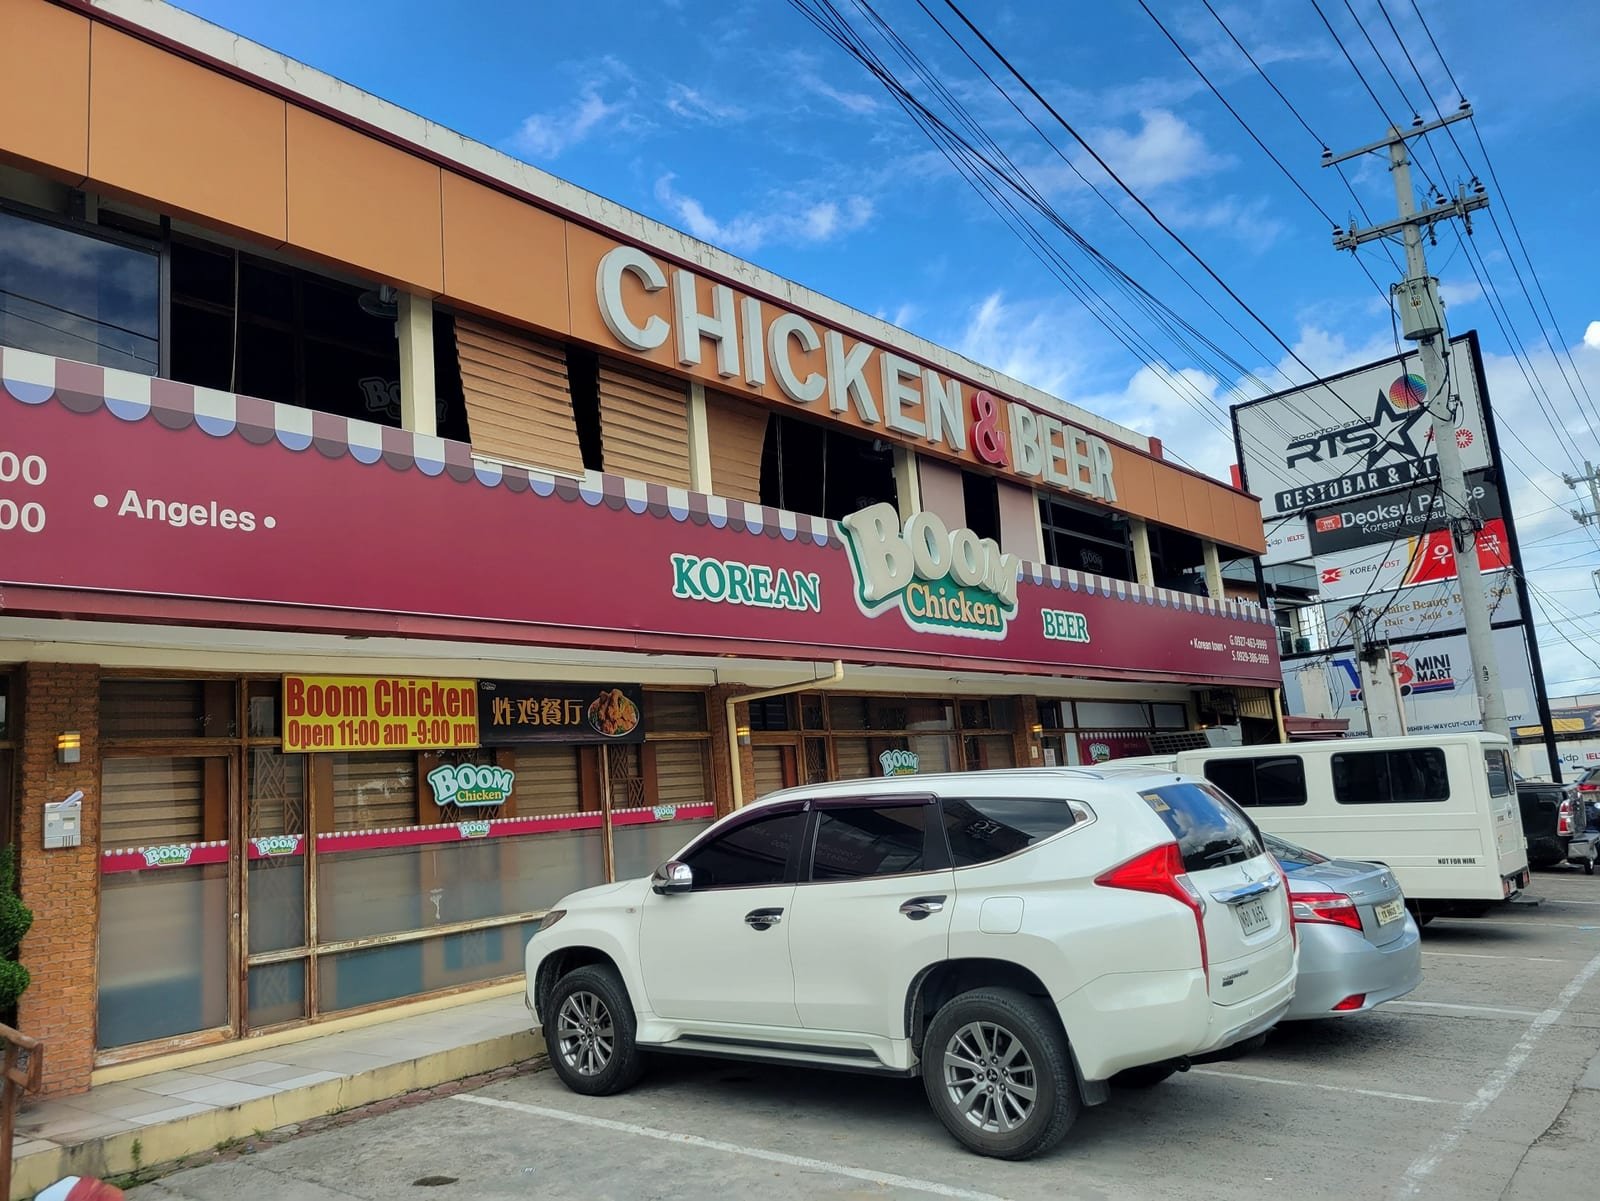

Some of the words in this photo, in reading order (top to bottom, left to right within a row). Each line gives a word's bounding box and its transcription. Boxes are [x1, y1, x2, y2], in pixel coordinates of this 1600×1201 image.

[597, 246, 966, 452] CHICKEN
[970, 389, 1008, 468] &
[1007, 402, 1117, 503] BEER
[1409, 457, 1436, 480] KT
[118, 489, 256, 532] Angeles
[1341, 502, 1412, 528] Deoksu
[1362, 519, 1401, 534] Korean
[842, 501, 1019, 608] BOOM
[1349, 563, 1378, 575] KOREA
[672, 554, 820, 612] KOREAN
[905, 583, 1001, 626] Chicken
[1042, 609, 1089, 642] BEER
[1415, 653, 1450, 672] MINI
[1417, 667, 1452, 683] MART
[287, 677, 368, 718] Boom
[374, 679, 476, 718] Chicken
[492, 696, 584, 726] 炸鸡餐厅
[288, 719, 335, 749] Open
[339, 719, 380, 746] 11:00
[383, 724, 407, 746] am
[453, 723, 476, 746] pm
[882, 752, 918, 773] BOOM
[1563, 753, 1579, 764] idp
[1585, 752, 1600, 761] IEL
[431, 766, 512, 800] BOOM
[456, 789, 502, 802] Chicken
[145, 847, 191, 865] BOOM
[257, 839, 298, 854] BOOM
